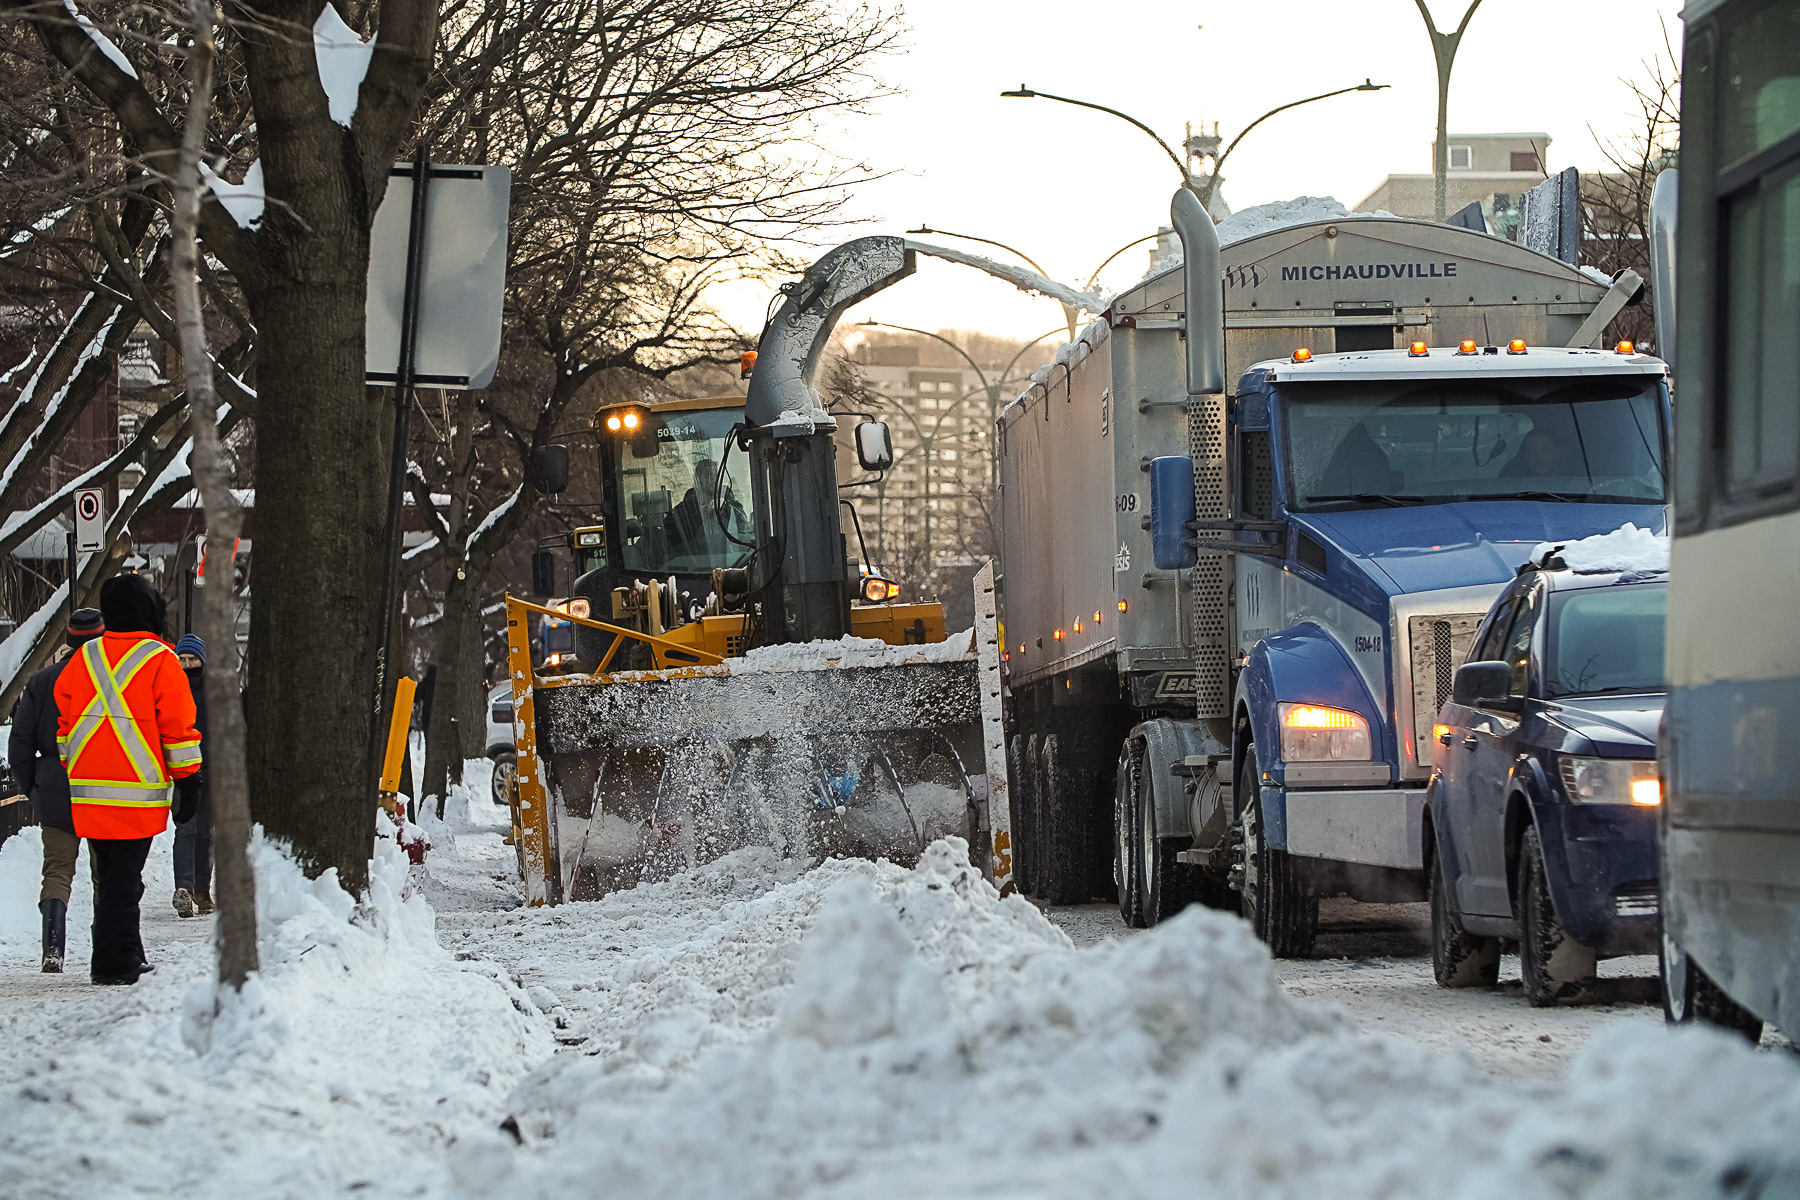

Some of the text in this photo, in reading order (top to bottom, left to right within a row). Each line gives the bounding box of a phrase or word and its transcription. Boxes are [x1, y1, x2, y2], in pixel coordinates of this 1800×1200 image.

[1281, 263, 1457, 281] MICHAUDVILLE
[657, 425, 696, 438] 5039-14
[1354, 636, 1382, 652] 1504-18
[1165, 677, 1198, 691] EAS
